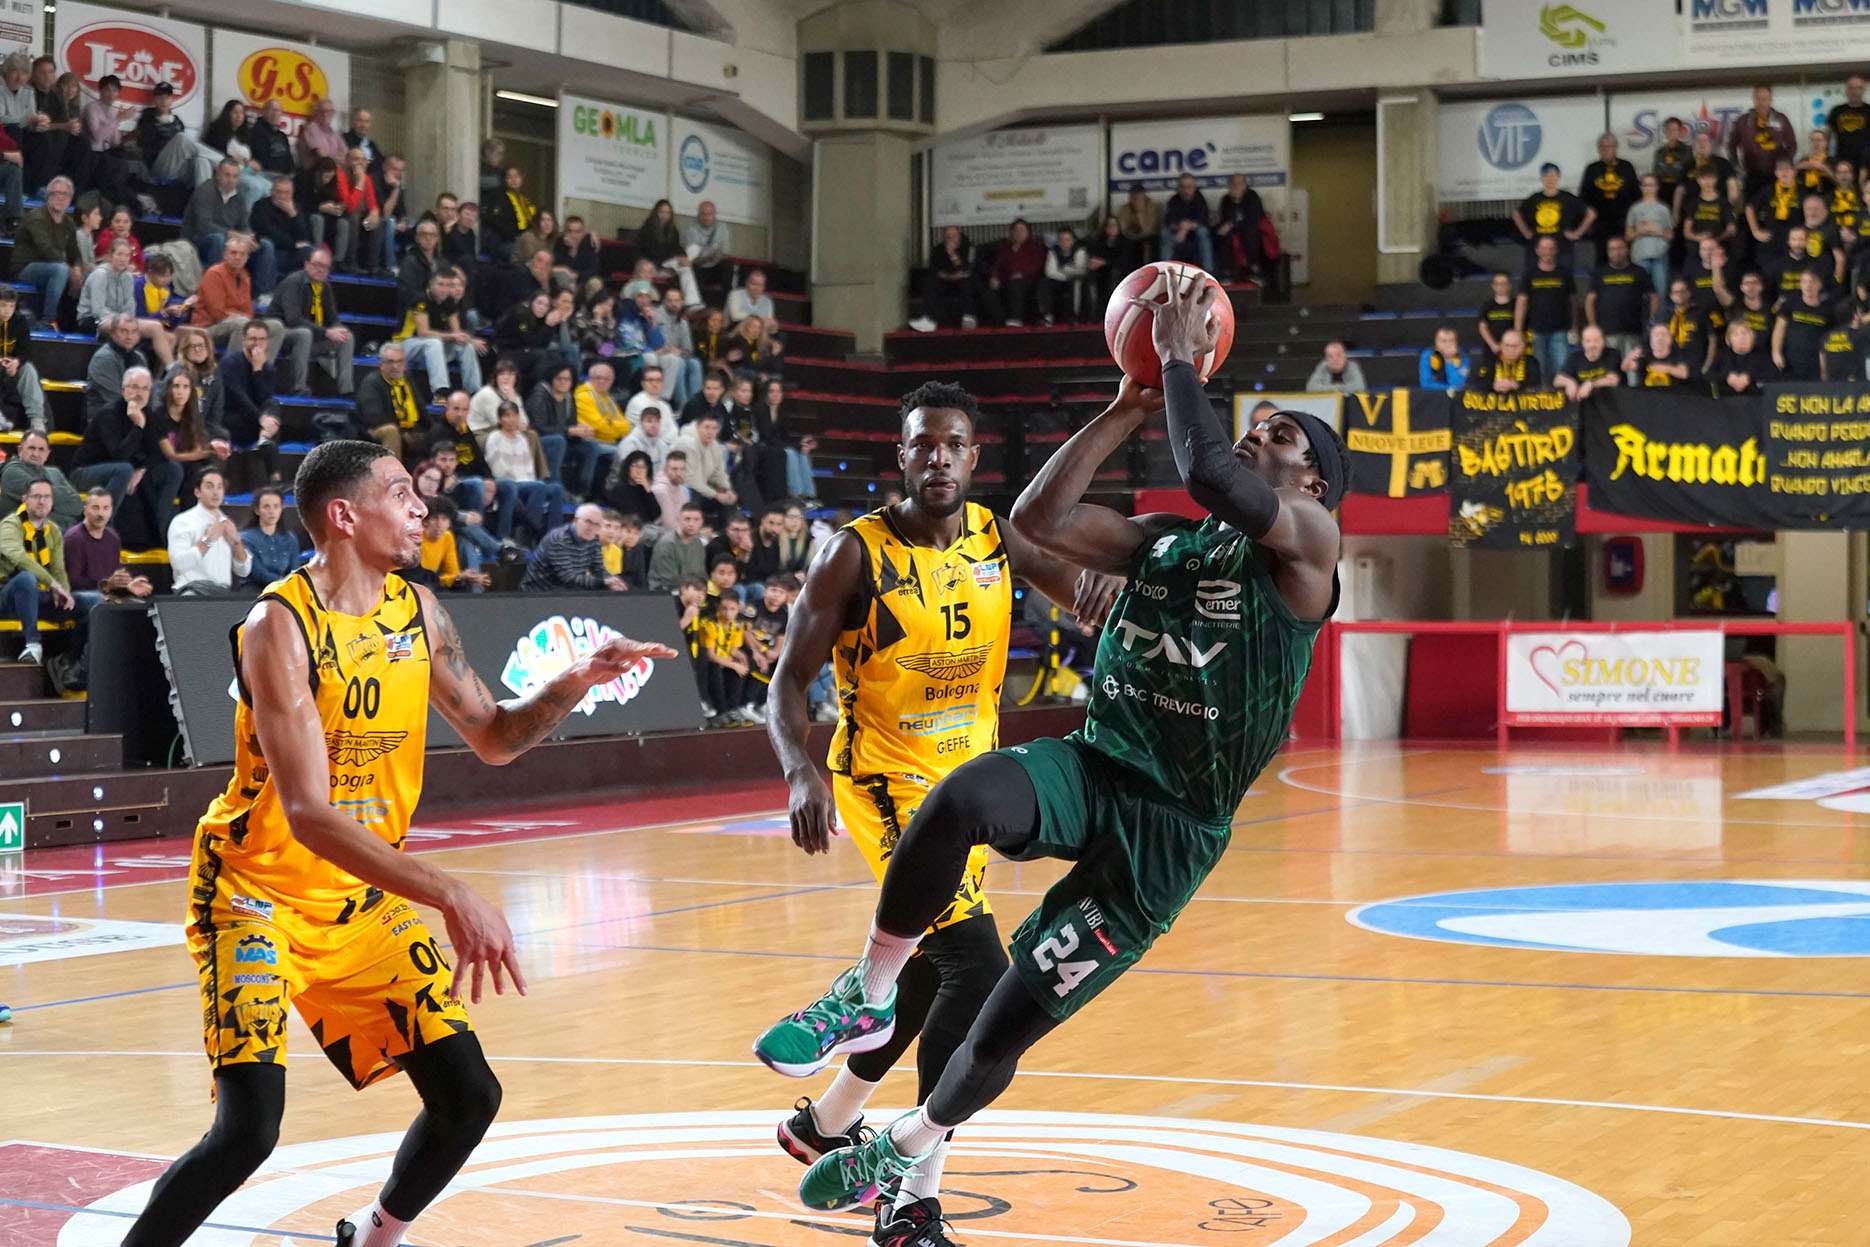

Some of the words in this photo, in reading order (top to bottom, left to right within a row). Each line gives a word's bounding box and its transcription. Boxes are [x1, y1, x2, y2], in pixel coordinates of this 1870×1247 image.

[1548, 52, 1599, 67] CIMS
[1776, 393, 1797, 414] SE
[940, 602, 971, 640] 15
[931, 658, 956, 668] ASTON
[1561, 656, 1702, 687] SIMONE
[343, 675, 381, 720] 00
[1568, 691, 1621, 707] sempre
[1626, 687, 1649, 702] nel
[1031, 922, 1100, 999] 24
